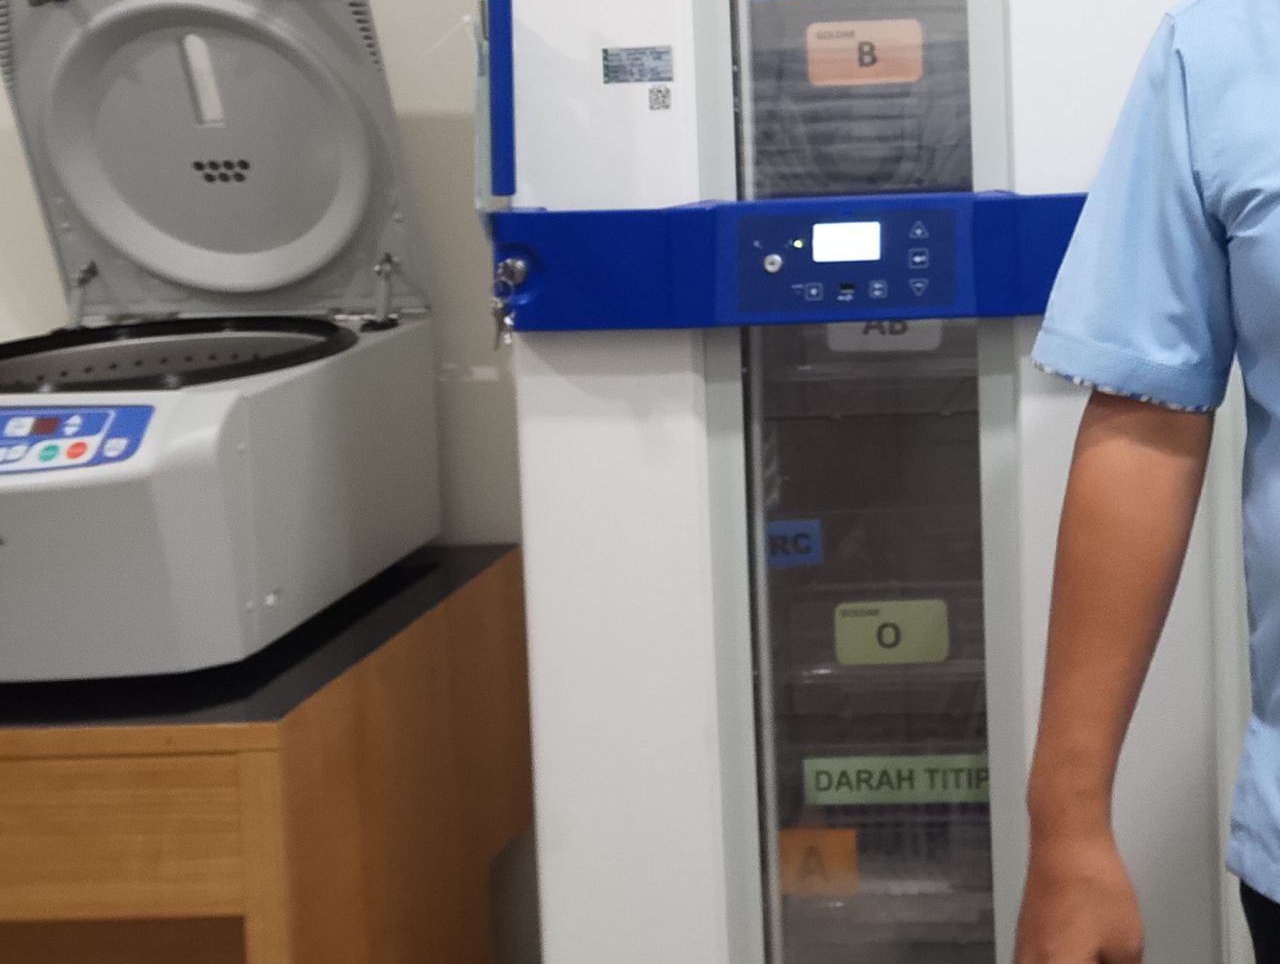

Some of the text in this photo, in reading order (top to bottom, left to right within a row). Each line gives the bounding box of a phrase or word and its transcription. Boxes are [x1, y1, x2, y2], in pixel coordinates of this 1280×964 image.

[856, 40, 878, 68] B
[876, 622, 901, 649] O
[814, 769, 915, 793] DARAH
[799, 845, 832, 884] A
